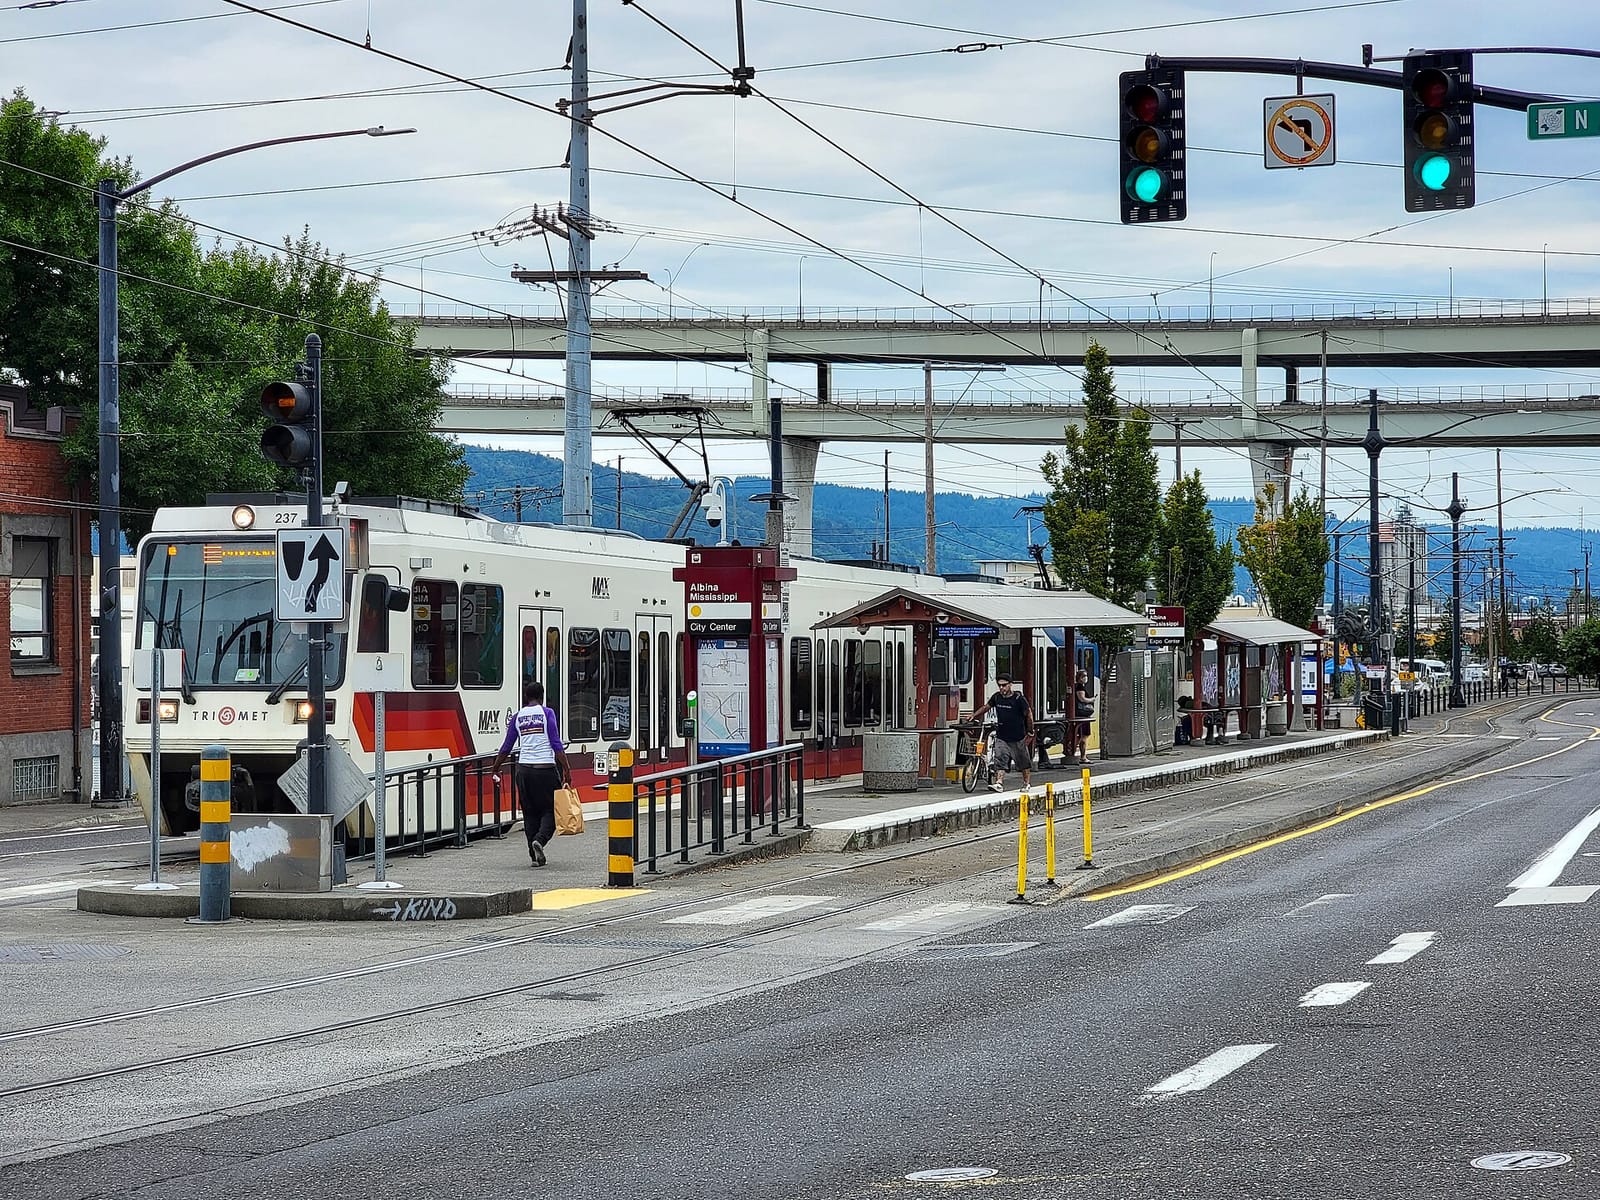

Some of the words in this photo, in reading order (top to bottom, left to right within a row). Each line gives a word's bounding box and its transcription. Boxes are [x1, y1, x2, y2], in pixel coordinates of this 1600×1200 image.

[1575, 109, 1588, 130] N
[274, 512, 298, 524] 237
[592, 576, 610, 596] MAX
[690, 583, 719, 592] Albina
[690, 592, 738, 602] Mississippi
[690, 622, 706, 632] City
[709, 622, 737, 631] Center
[478, 710, 501, 731] MAX
